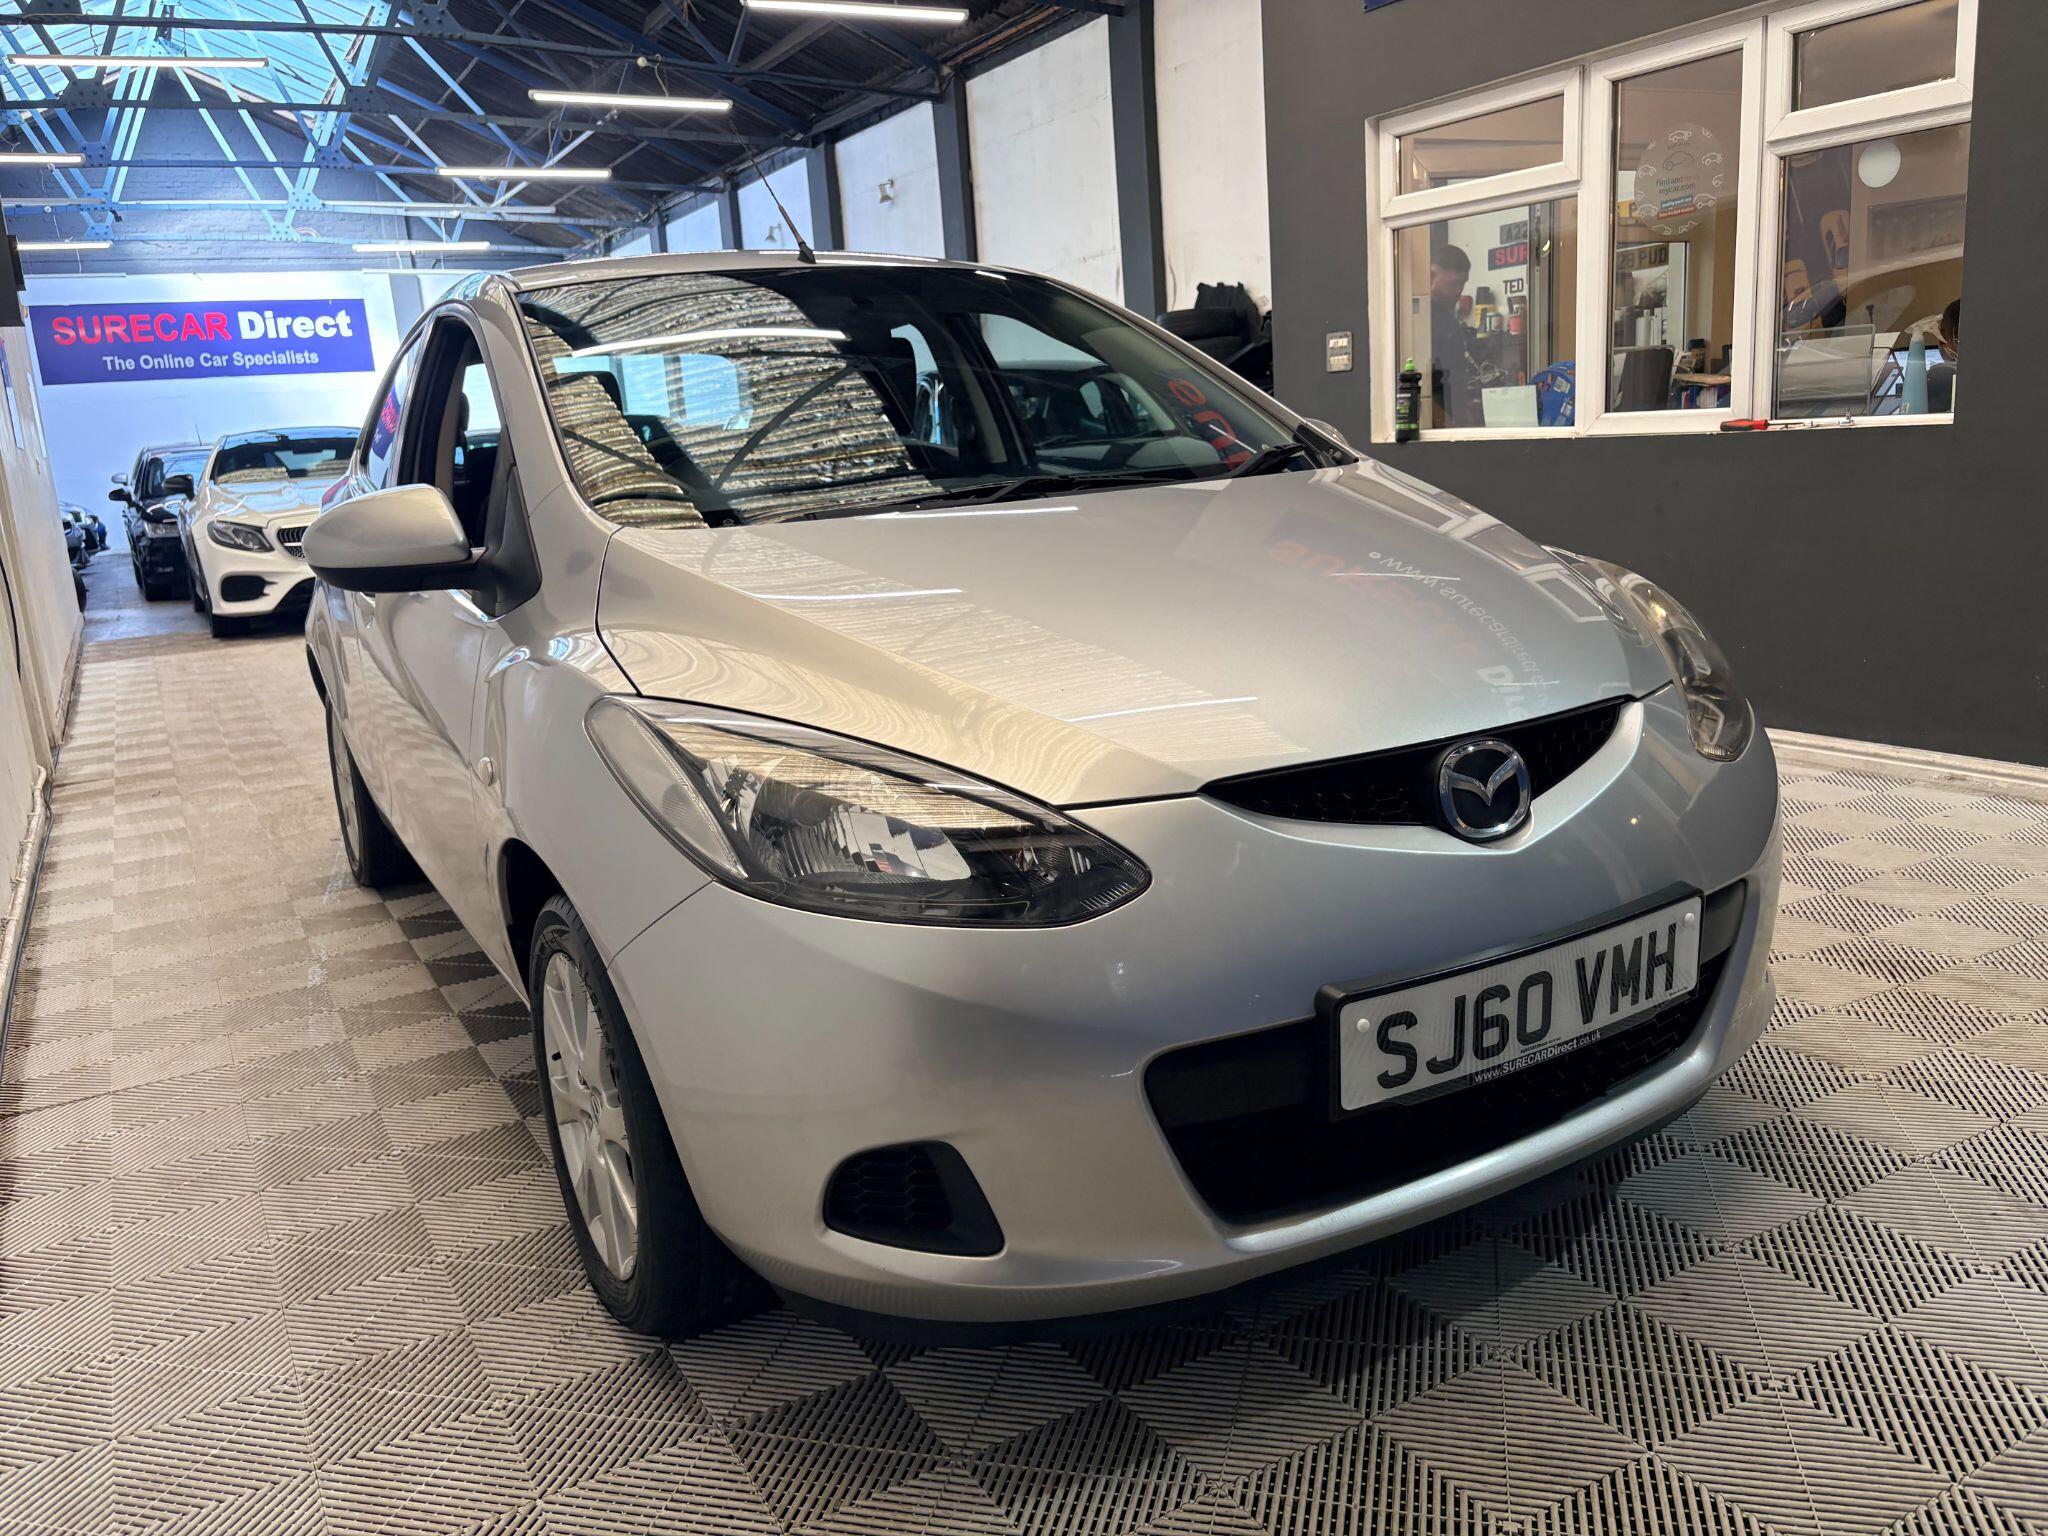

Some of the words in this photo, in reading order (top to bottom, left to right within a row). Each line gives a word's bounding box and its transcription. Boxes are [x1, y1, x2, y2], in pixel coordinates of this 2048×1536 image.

[1503, 277, 1524, 295] TED
[52, 312, 232, 346] SURECAR
[237, 309, 353, 340] Direct
[102, 355, 136, 372] The
[139, 353, 195, 371] Online
[200, 352, 228, 368] Car
[233, 350, 319, 368] Specialists
[1376, 970, 1553, 1089] SJ60
[1575, 923, 1677, 1025] VMH
[1474, 1030, 1601, 1084] www.SURECARDirect.co.uk
